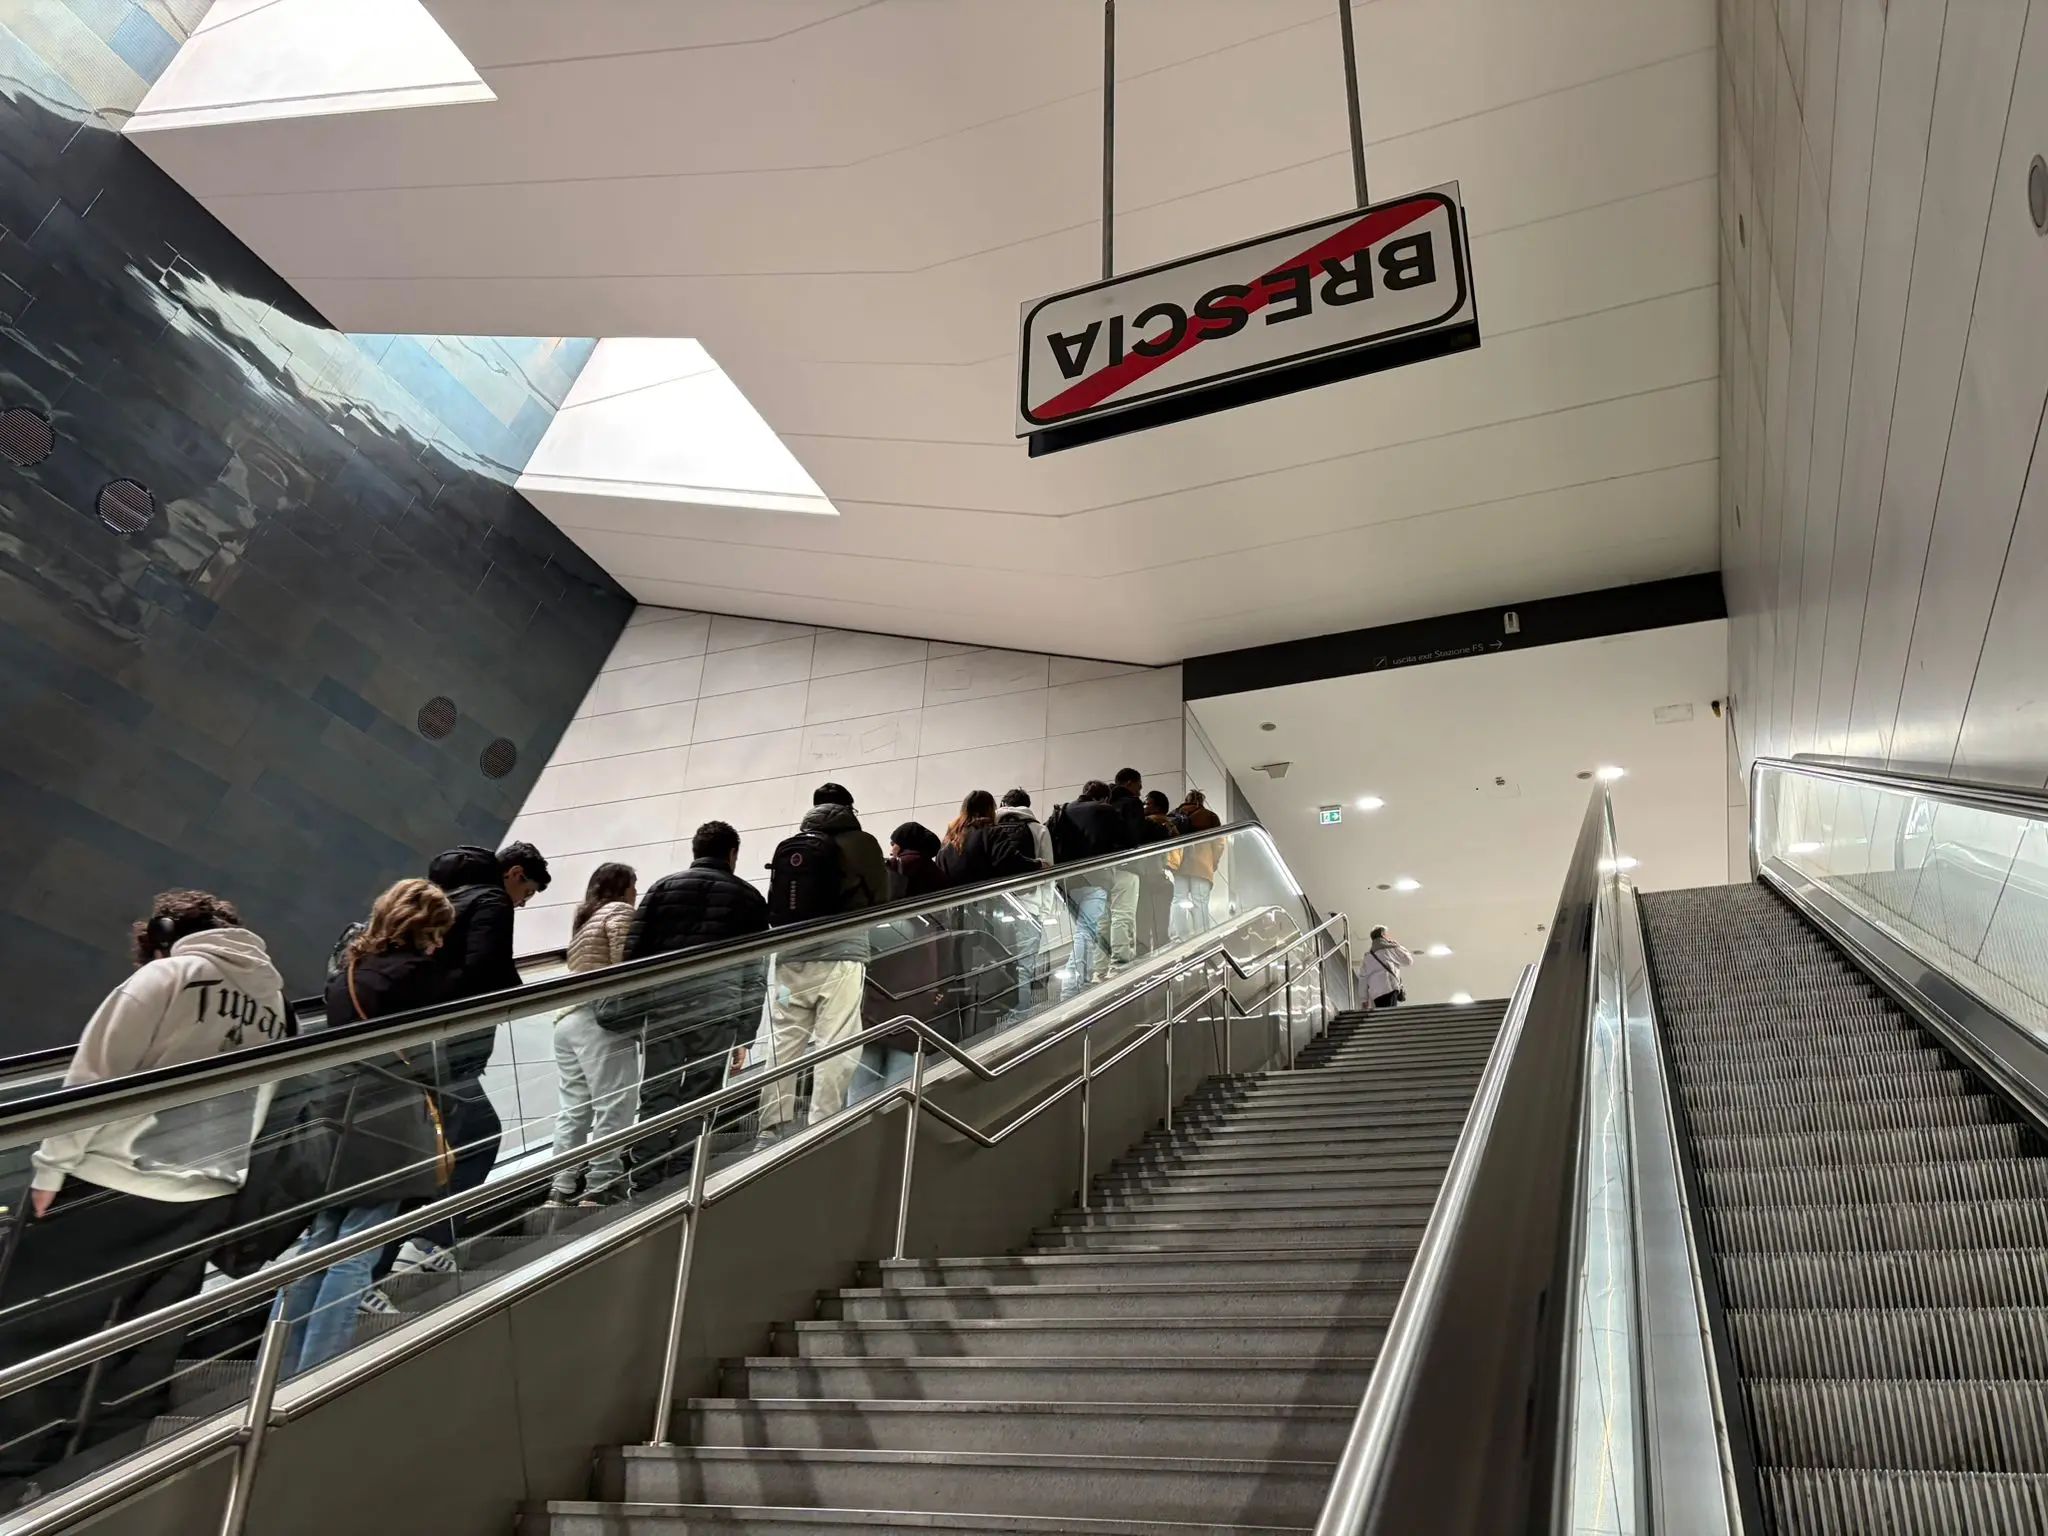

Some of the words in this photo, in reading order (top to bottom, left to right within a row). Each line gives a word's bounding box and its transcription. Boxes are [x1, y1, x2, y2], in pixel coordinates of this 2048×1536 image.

[1047, 231, 1436, 379] BRESCIA
[1392, 655, 1417, 665] uscita
[1418, 652, 1433, 661] exit
[1434, 646, 1471, 658] Stazione
[1472, 643, 1485, 652] FS
